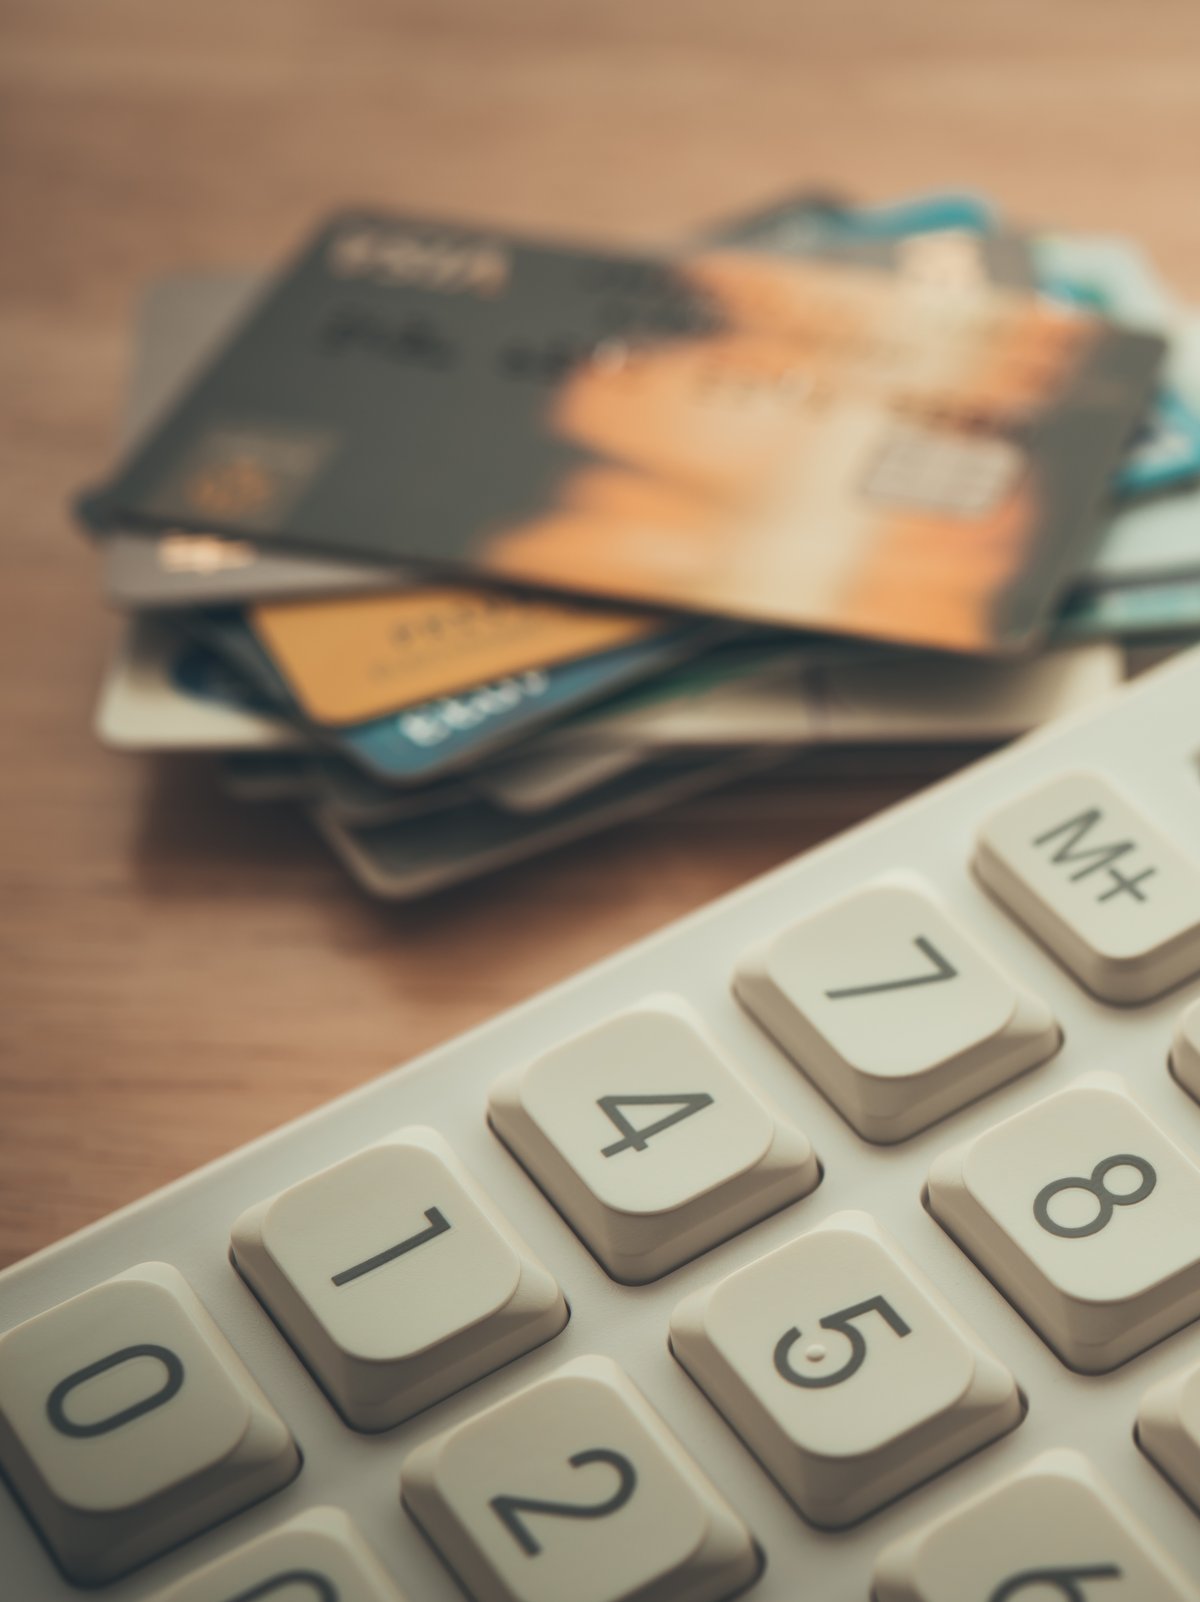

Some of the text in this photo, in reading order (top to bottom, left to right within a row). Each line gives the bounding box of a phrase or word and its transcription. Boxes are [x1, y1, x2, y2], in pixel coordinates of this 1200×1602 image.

[1032, 808, 1156, 903] M+
[825, 936, 958, 999] 7
[596, 1092, 715, 1158] 4
[1032, 1153, 1158, 1239] 8
[330, 1206, 452, 1287] 1
[773, 1295, 912, 1390] 5
[45, 1342, 185, 1440] 0
[488, 1447, 638, 1557] 2
